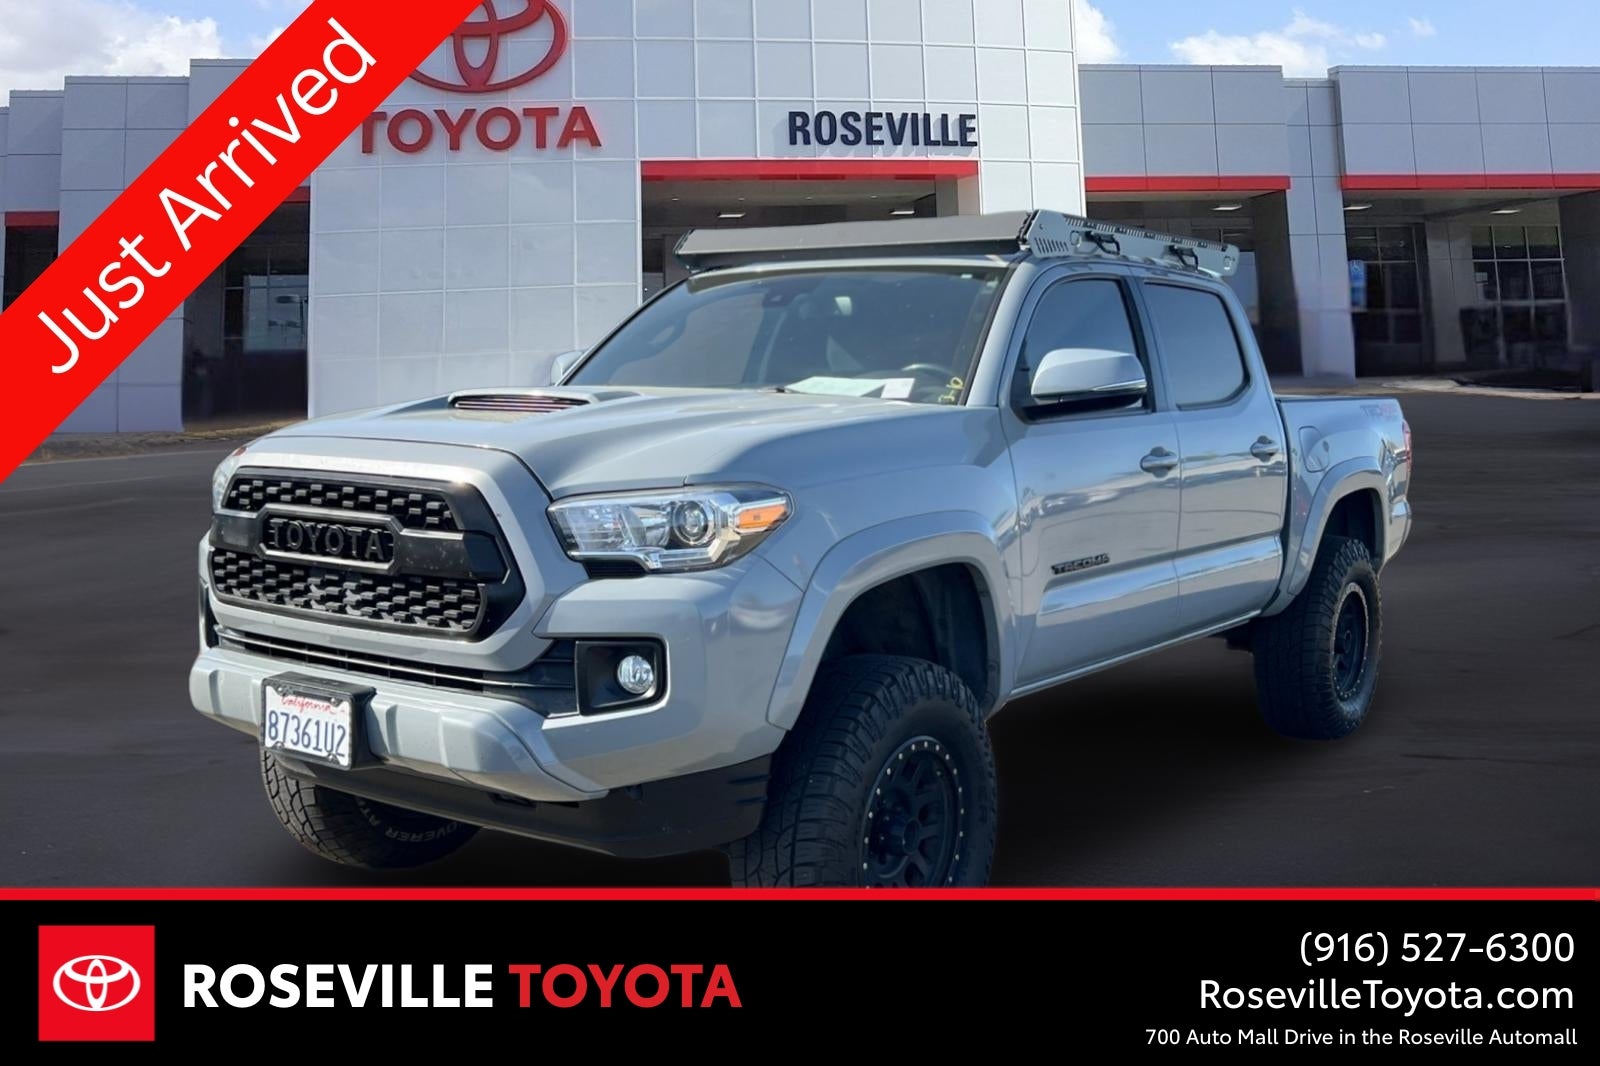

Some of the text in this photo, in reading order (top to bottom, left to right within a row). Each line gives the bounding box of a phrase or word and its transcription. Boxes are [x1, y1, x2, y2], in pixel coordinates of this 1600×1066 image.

[361, 106, 602, 154] TOYOTA
[787, 110, 978, 148] ROSEVILLE
[269, 517, 385, 562] TOYOTA
[268, 710, 346, 758] 87361U2
